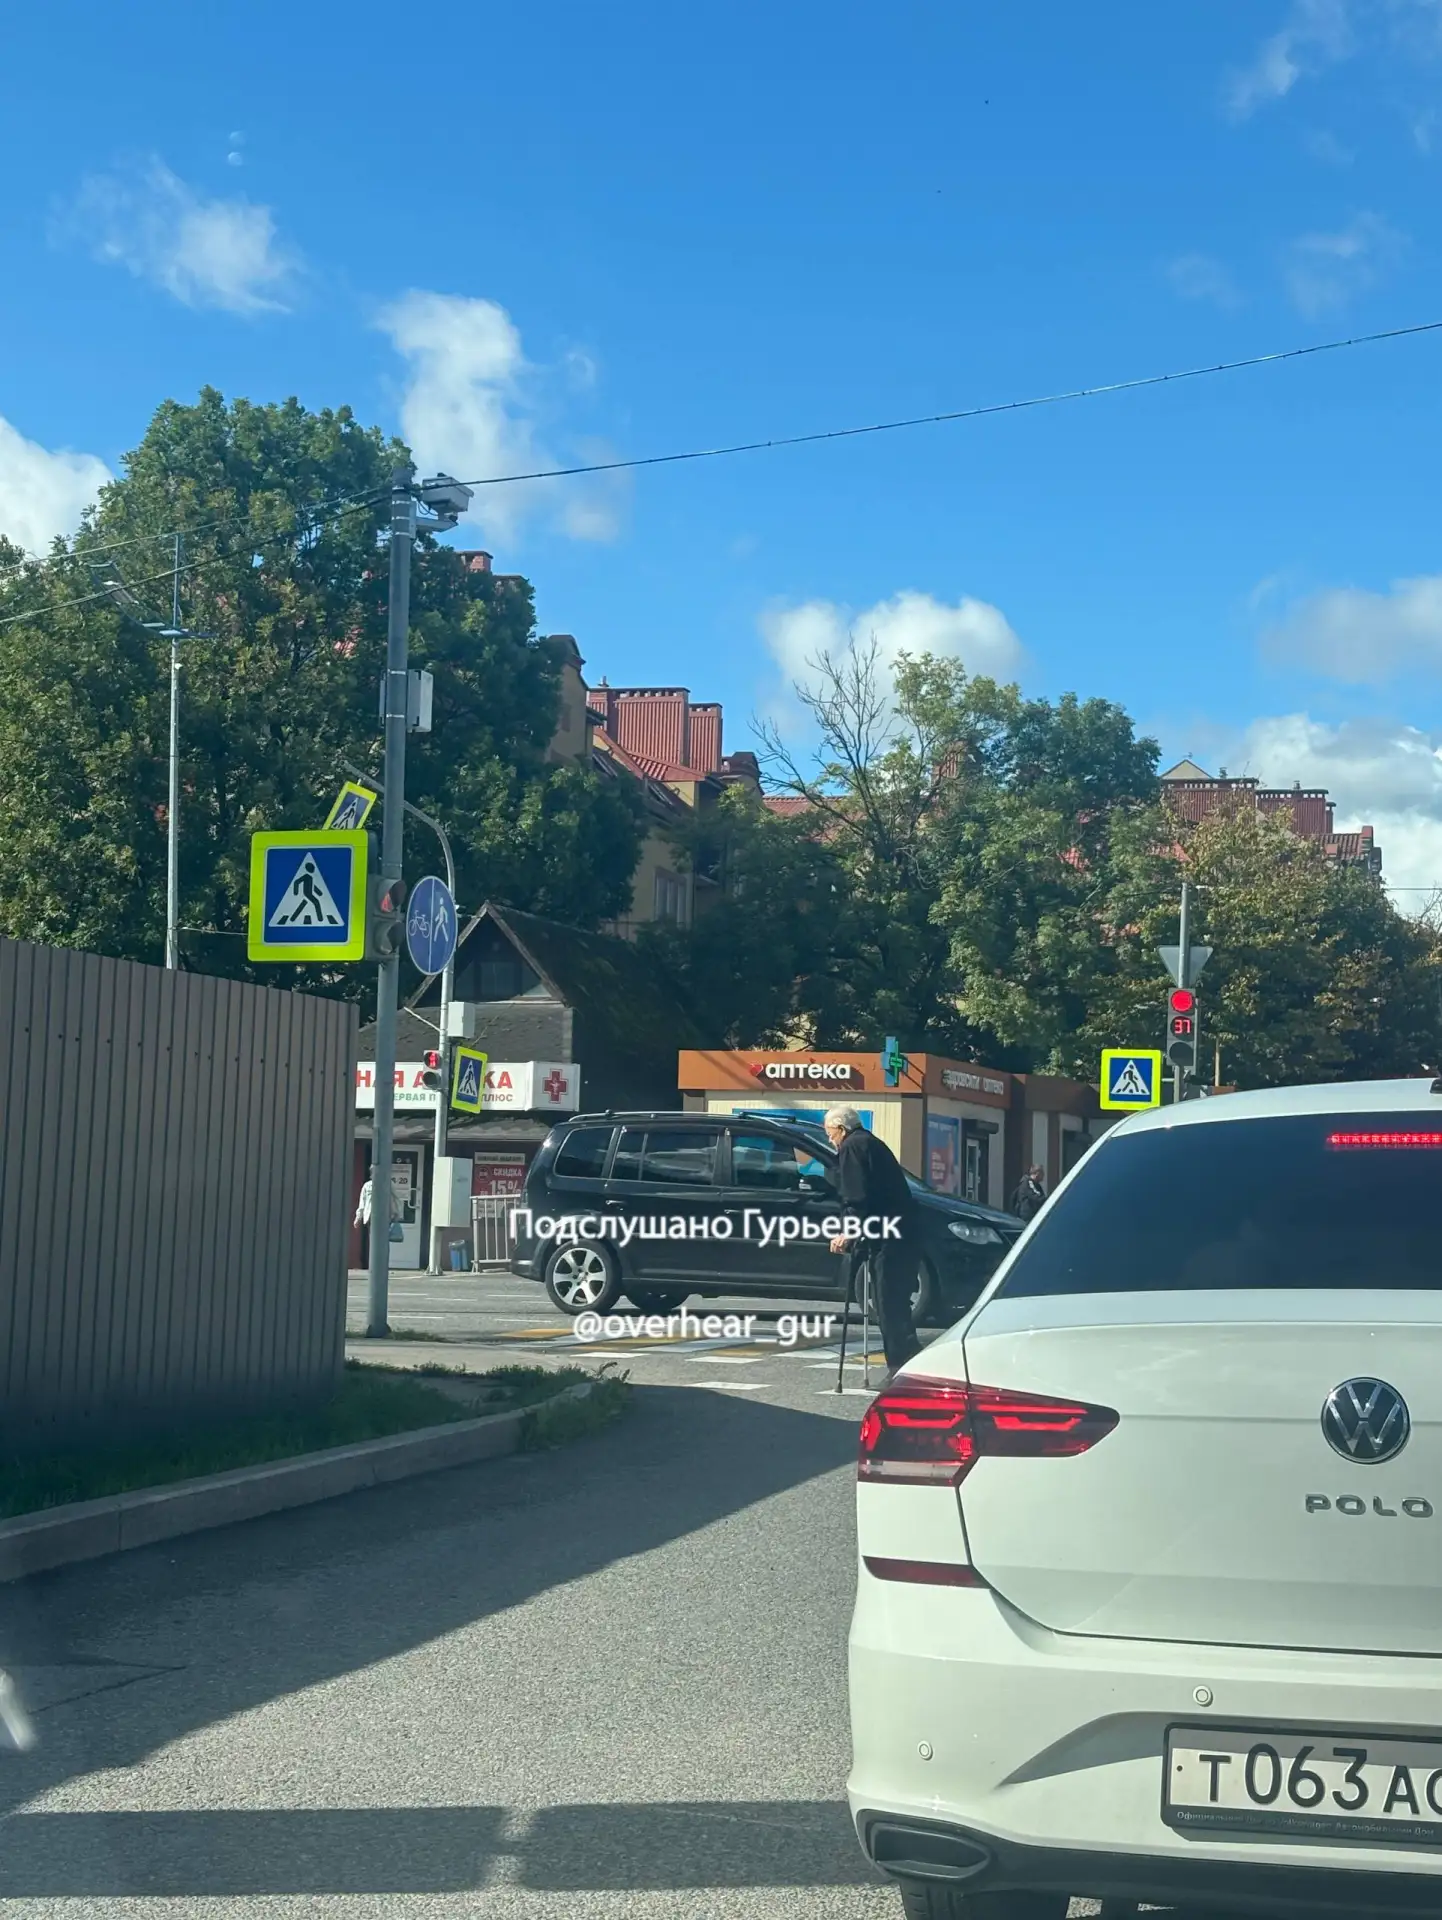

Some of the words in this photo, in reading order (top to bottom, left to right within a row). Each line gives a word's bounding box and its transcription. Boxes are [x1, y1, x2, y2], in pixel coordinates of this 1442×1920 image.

[1174, 1020, 1191, 1034] 37
[765, 1062, 851, 1079] аптека
[493, 1167, 523, 1177] СКИДКА
[489, 1179, 522, 1196] 15%
[1305, 1493, 1434, 1518] POLO
